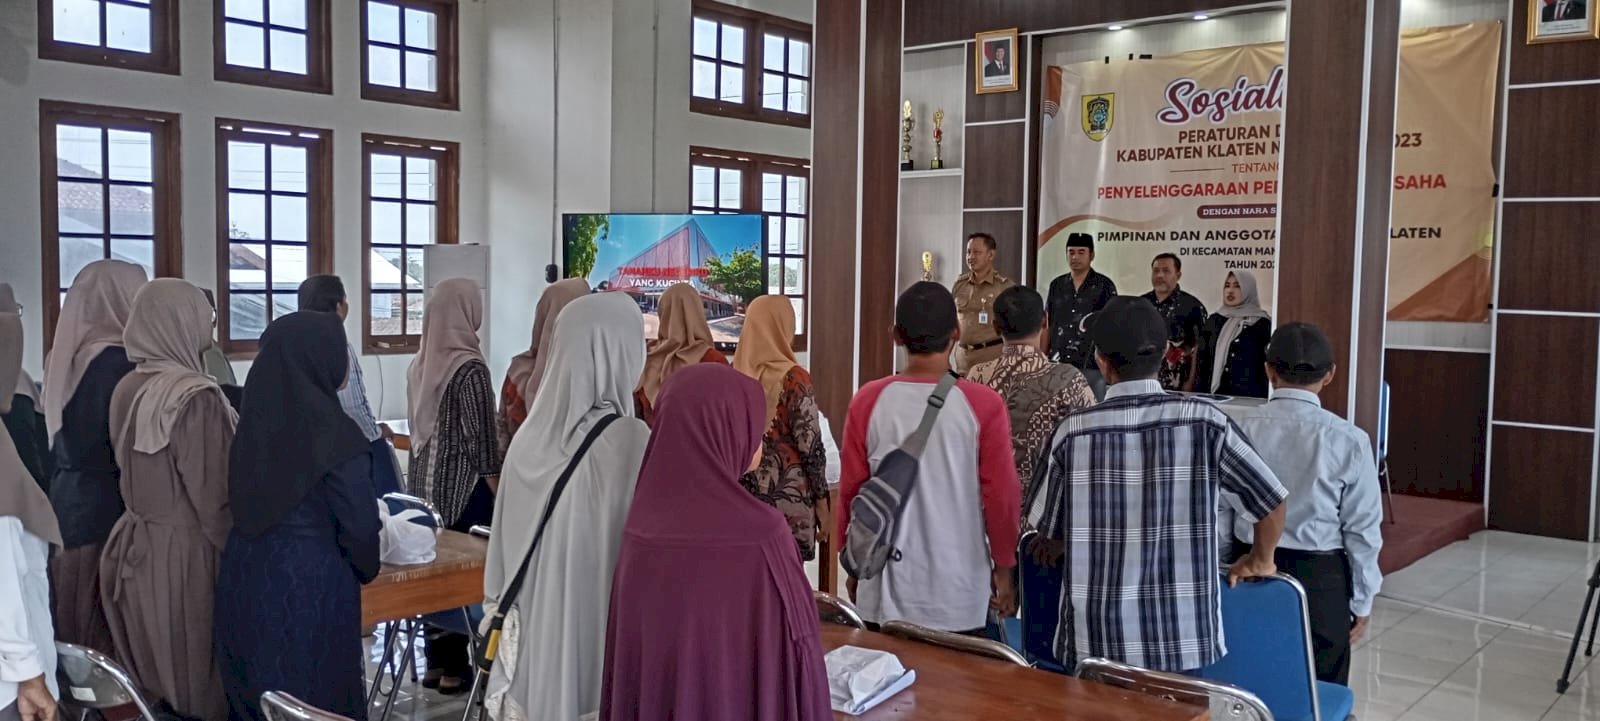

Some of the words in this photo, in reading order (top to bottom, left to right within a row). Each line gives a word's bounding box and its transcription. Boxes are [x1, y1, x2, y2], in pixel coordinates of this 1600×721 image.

[1178, 125, 1271, 144] PERATURAN
[1116, 146, 1202, 163] KABUPATEN
[1207, 142, 1266, 158] KLATEN
[1098, 181, 1248, 199] PENYELENGGARAAN
[1203, 207, 1241, 216] DENGAN
[1242, 207, 1268, 215] NARA
[1098, 231, 1165, 242] PIMPINAN
[1170, 230, 1200, 241] DAN
[1180, 247, 1190, 256] DI
[1192, 247, 1252, 256] KECAMATAN
[1224, 260, 1257, 269] TAHUN
[629, 279, 654, 287] YANG
